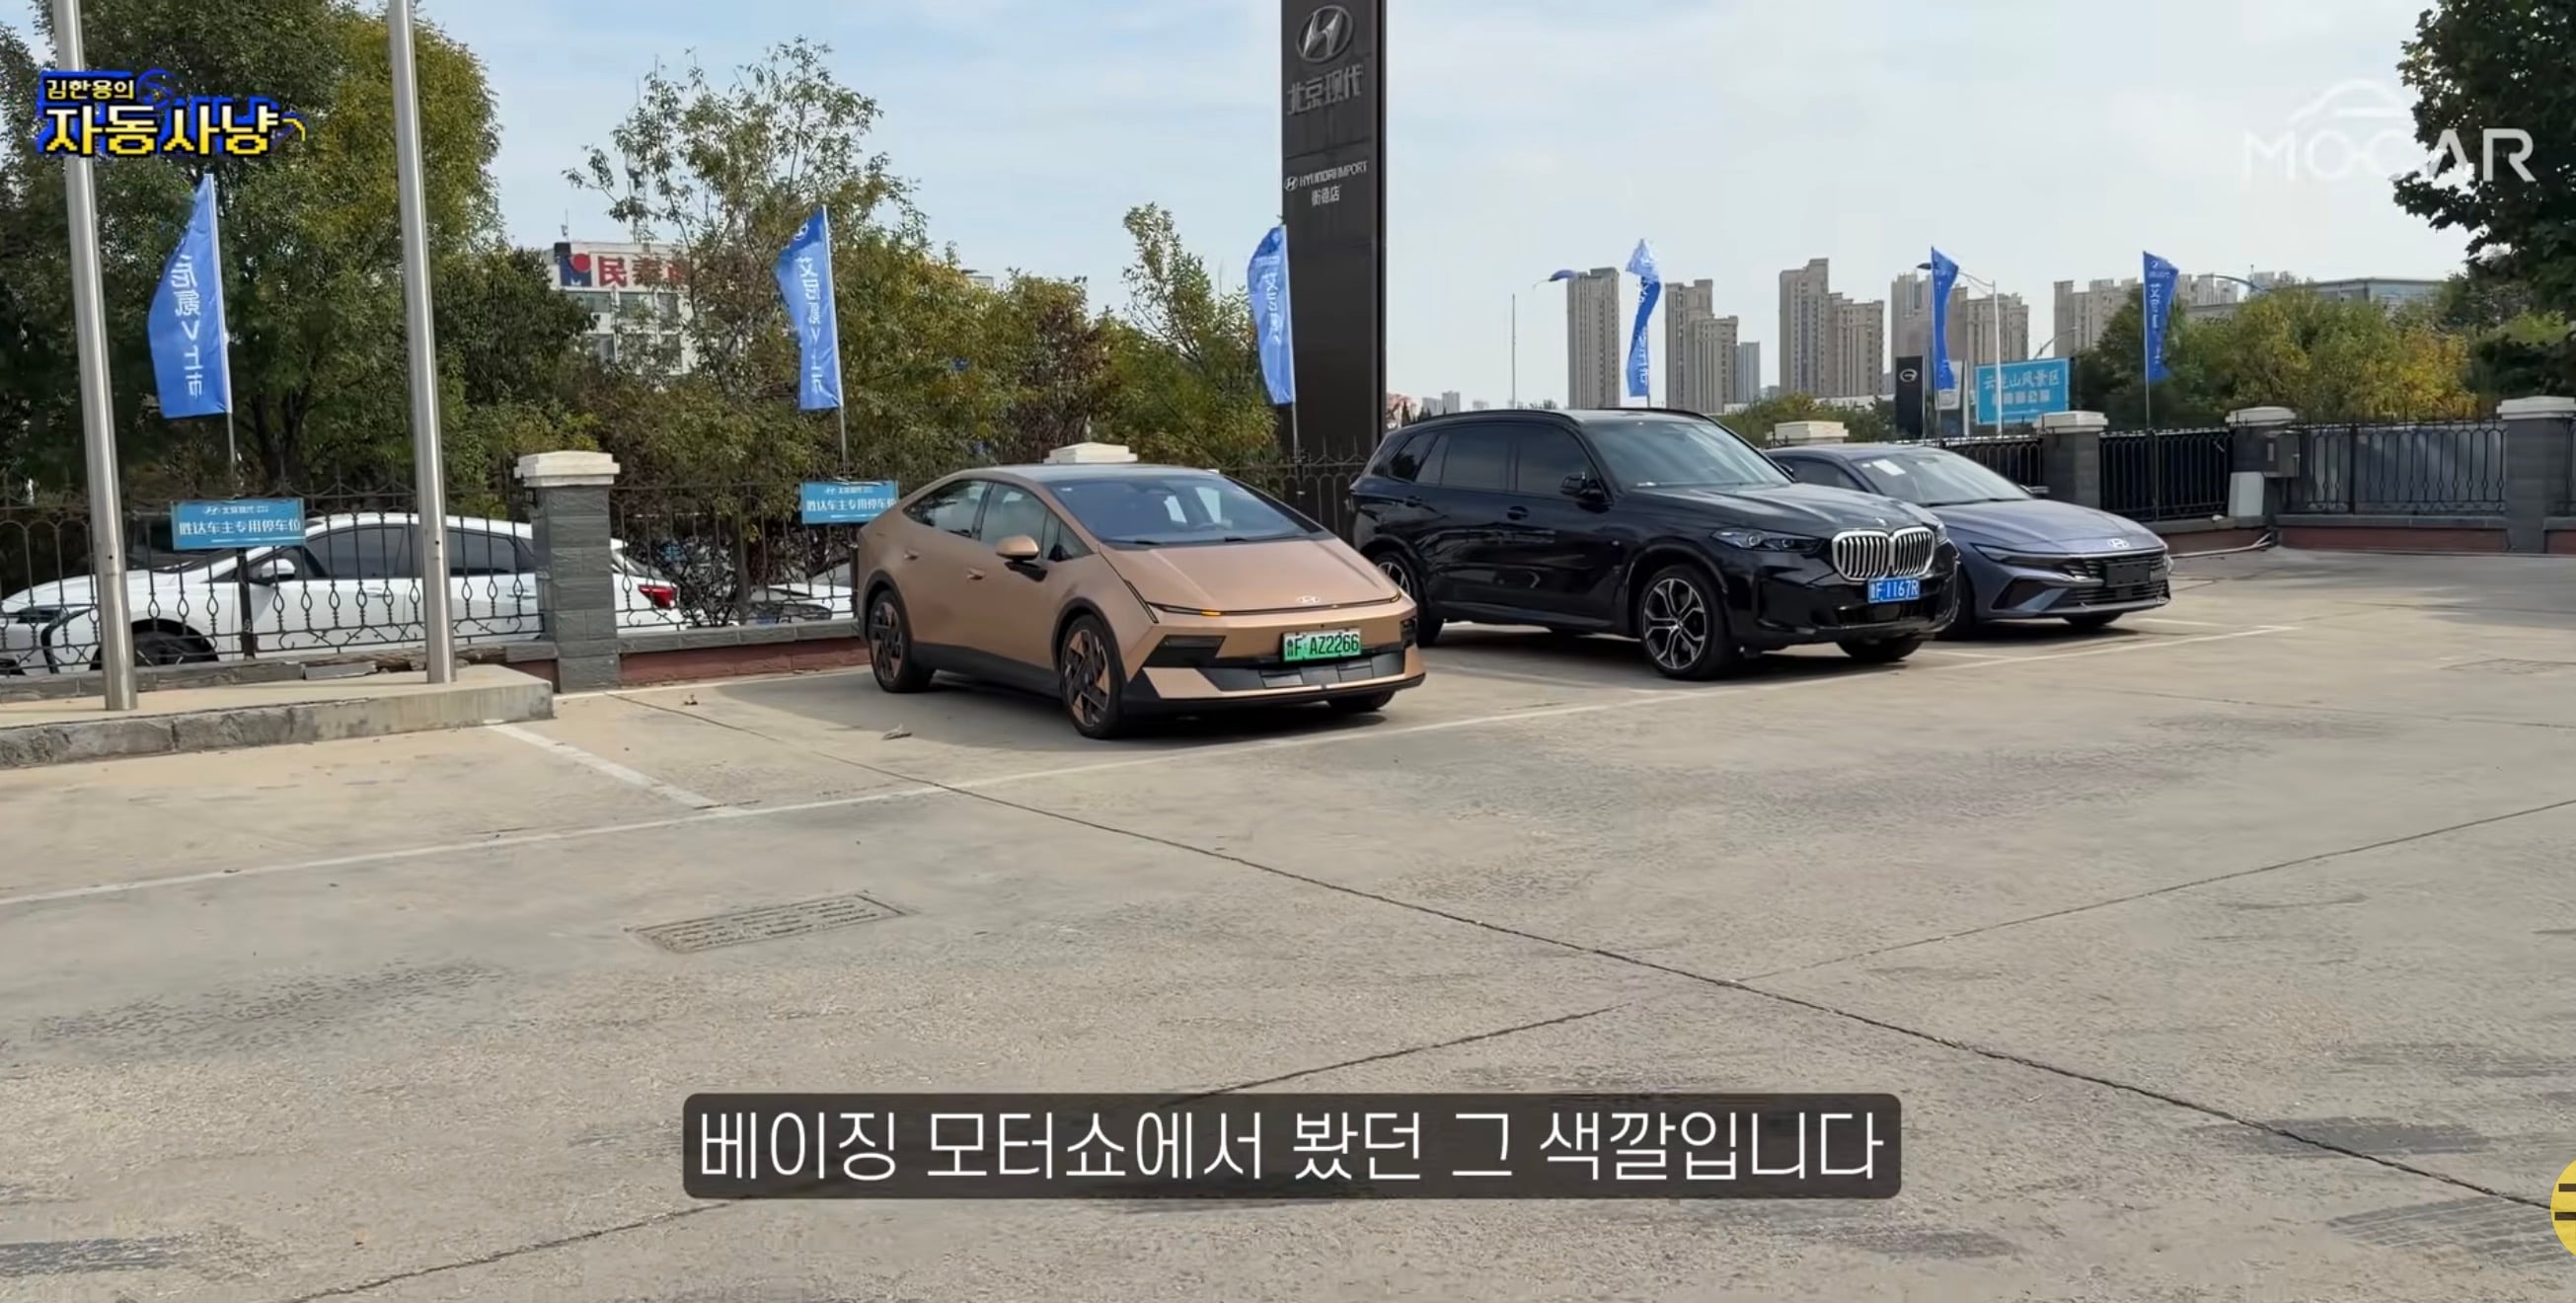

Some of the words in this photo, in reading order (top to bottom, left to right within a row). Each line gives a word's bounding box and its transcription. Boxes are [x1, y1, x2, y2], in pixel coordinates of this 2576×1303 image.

[1286, 64, 1364, 115] 北京现代
[1299, 168, 1337, 188] HYUNDAI
[1337, 161, 1368, 179] IMPORT
